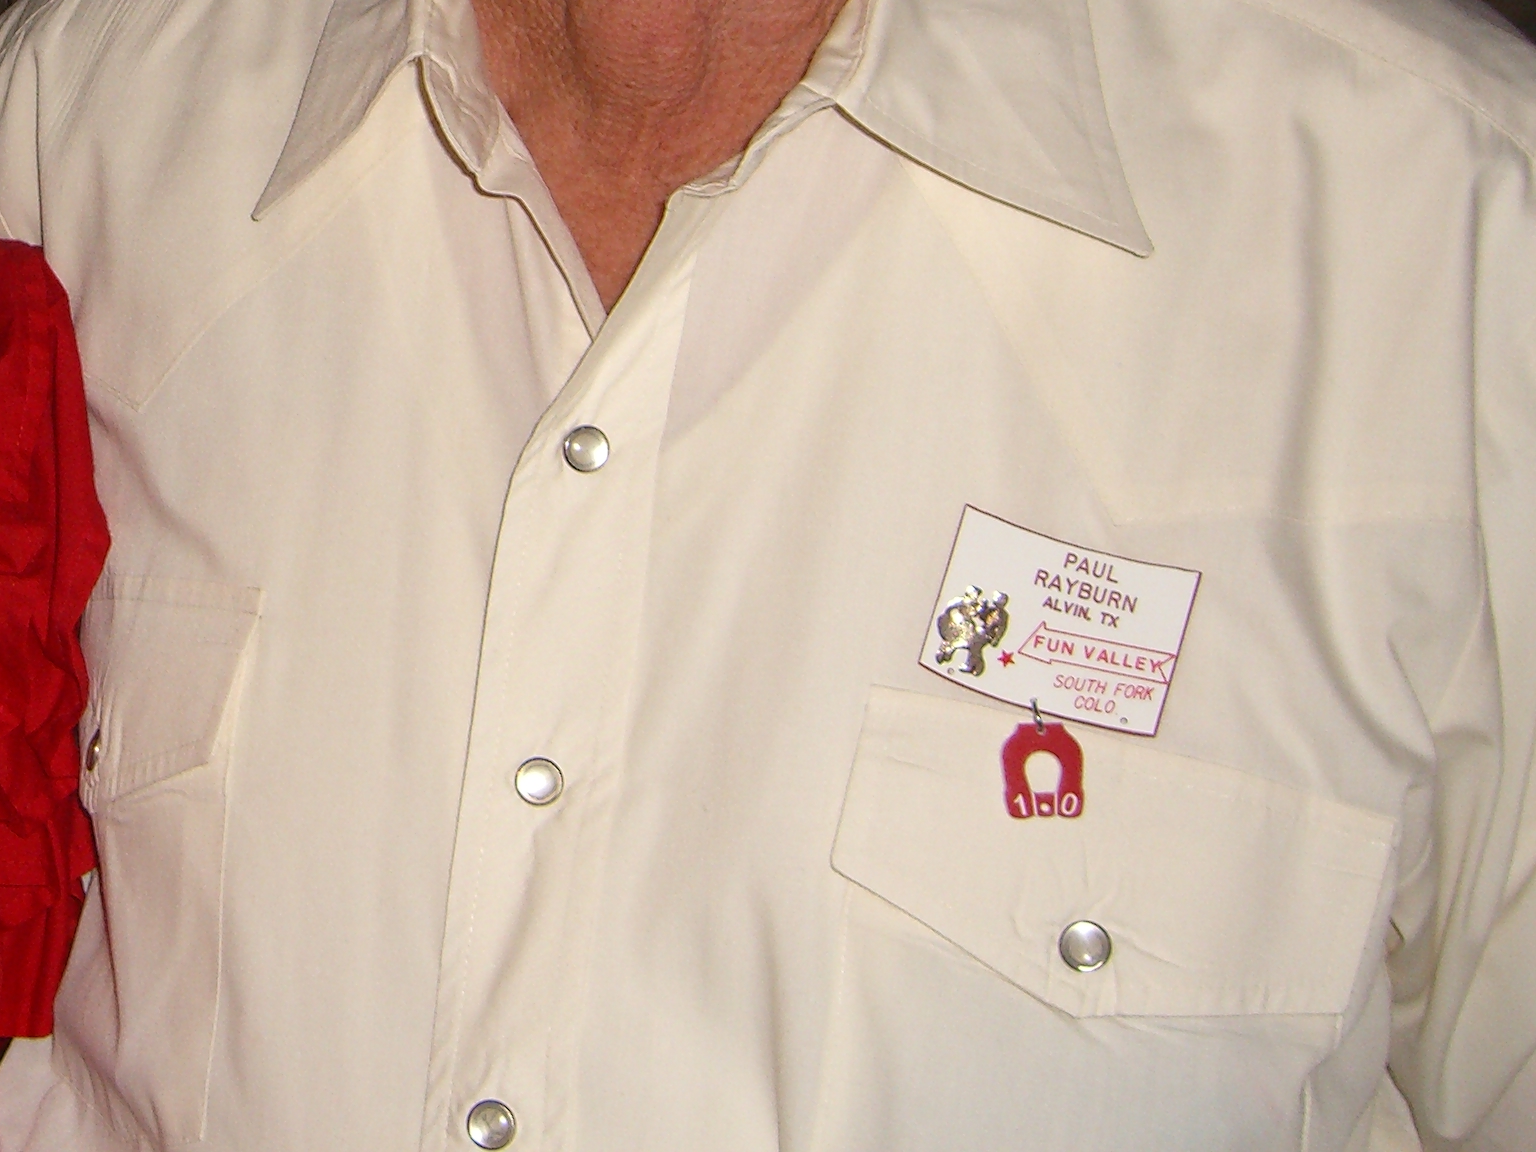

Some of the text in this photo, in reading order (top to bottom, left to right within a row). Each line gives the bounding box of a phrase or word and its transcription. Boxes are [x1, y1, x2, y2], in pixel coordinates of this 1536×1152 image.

[1064, 552, 1118, 583] PAUL
[1034, 569, 1137, 613] RAYBURN
[1100, 612, 1119, 628] TX
[1034, 635, 1161, 673] FUN VALLEY
[1053, 674, 1154, 700] SOUTH FORK
